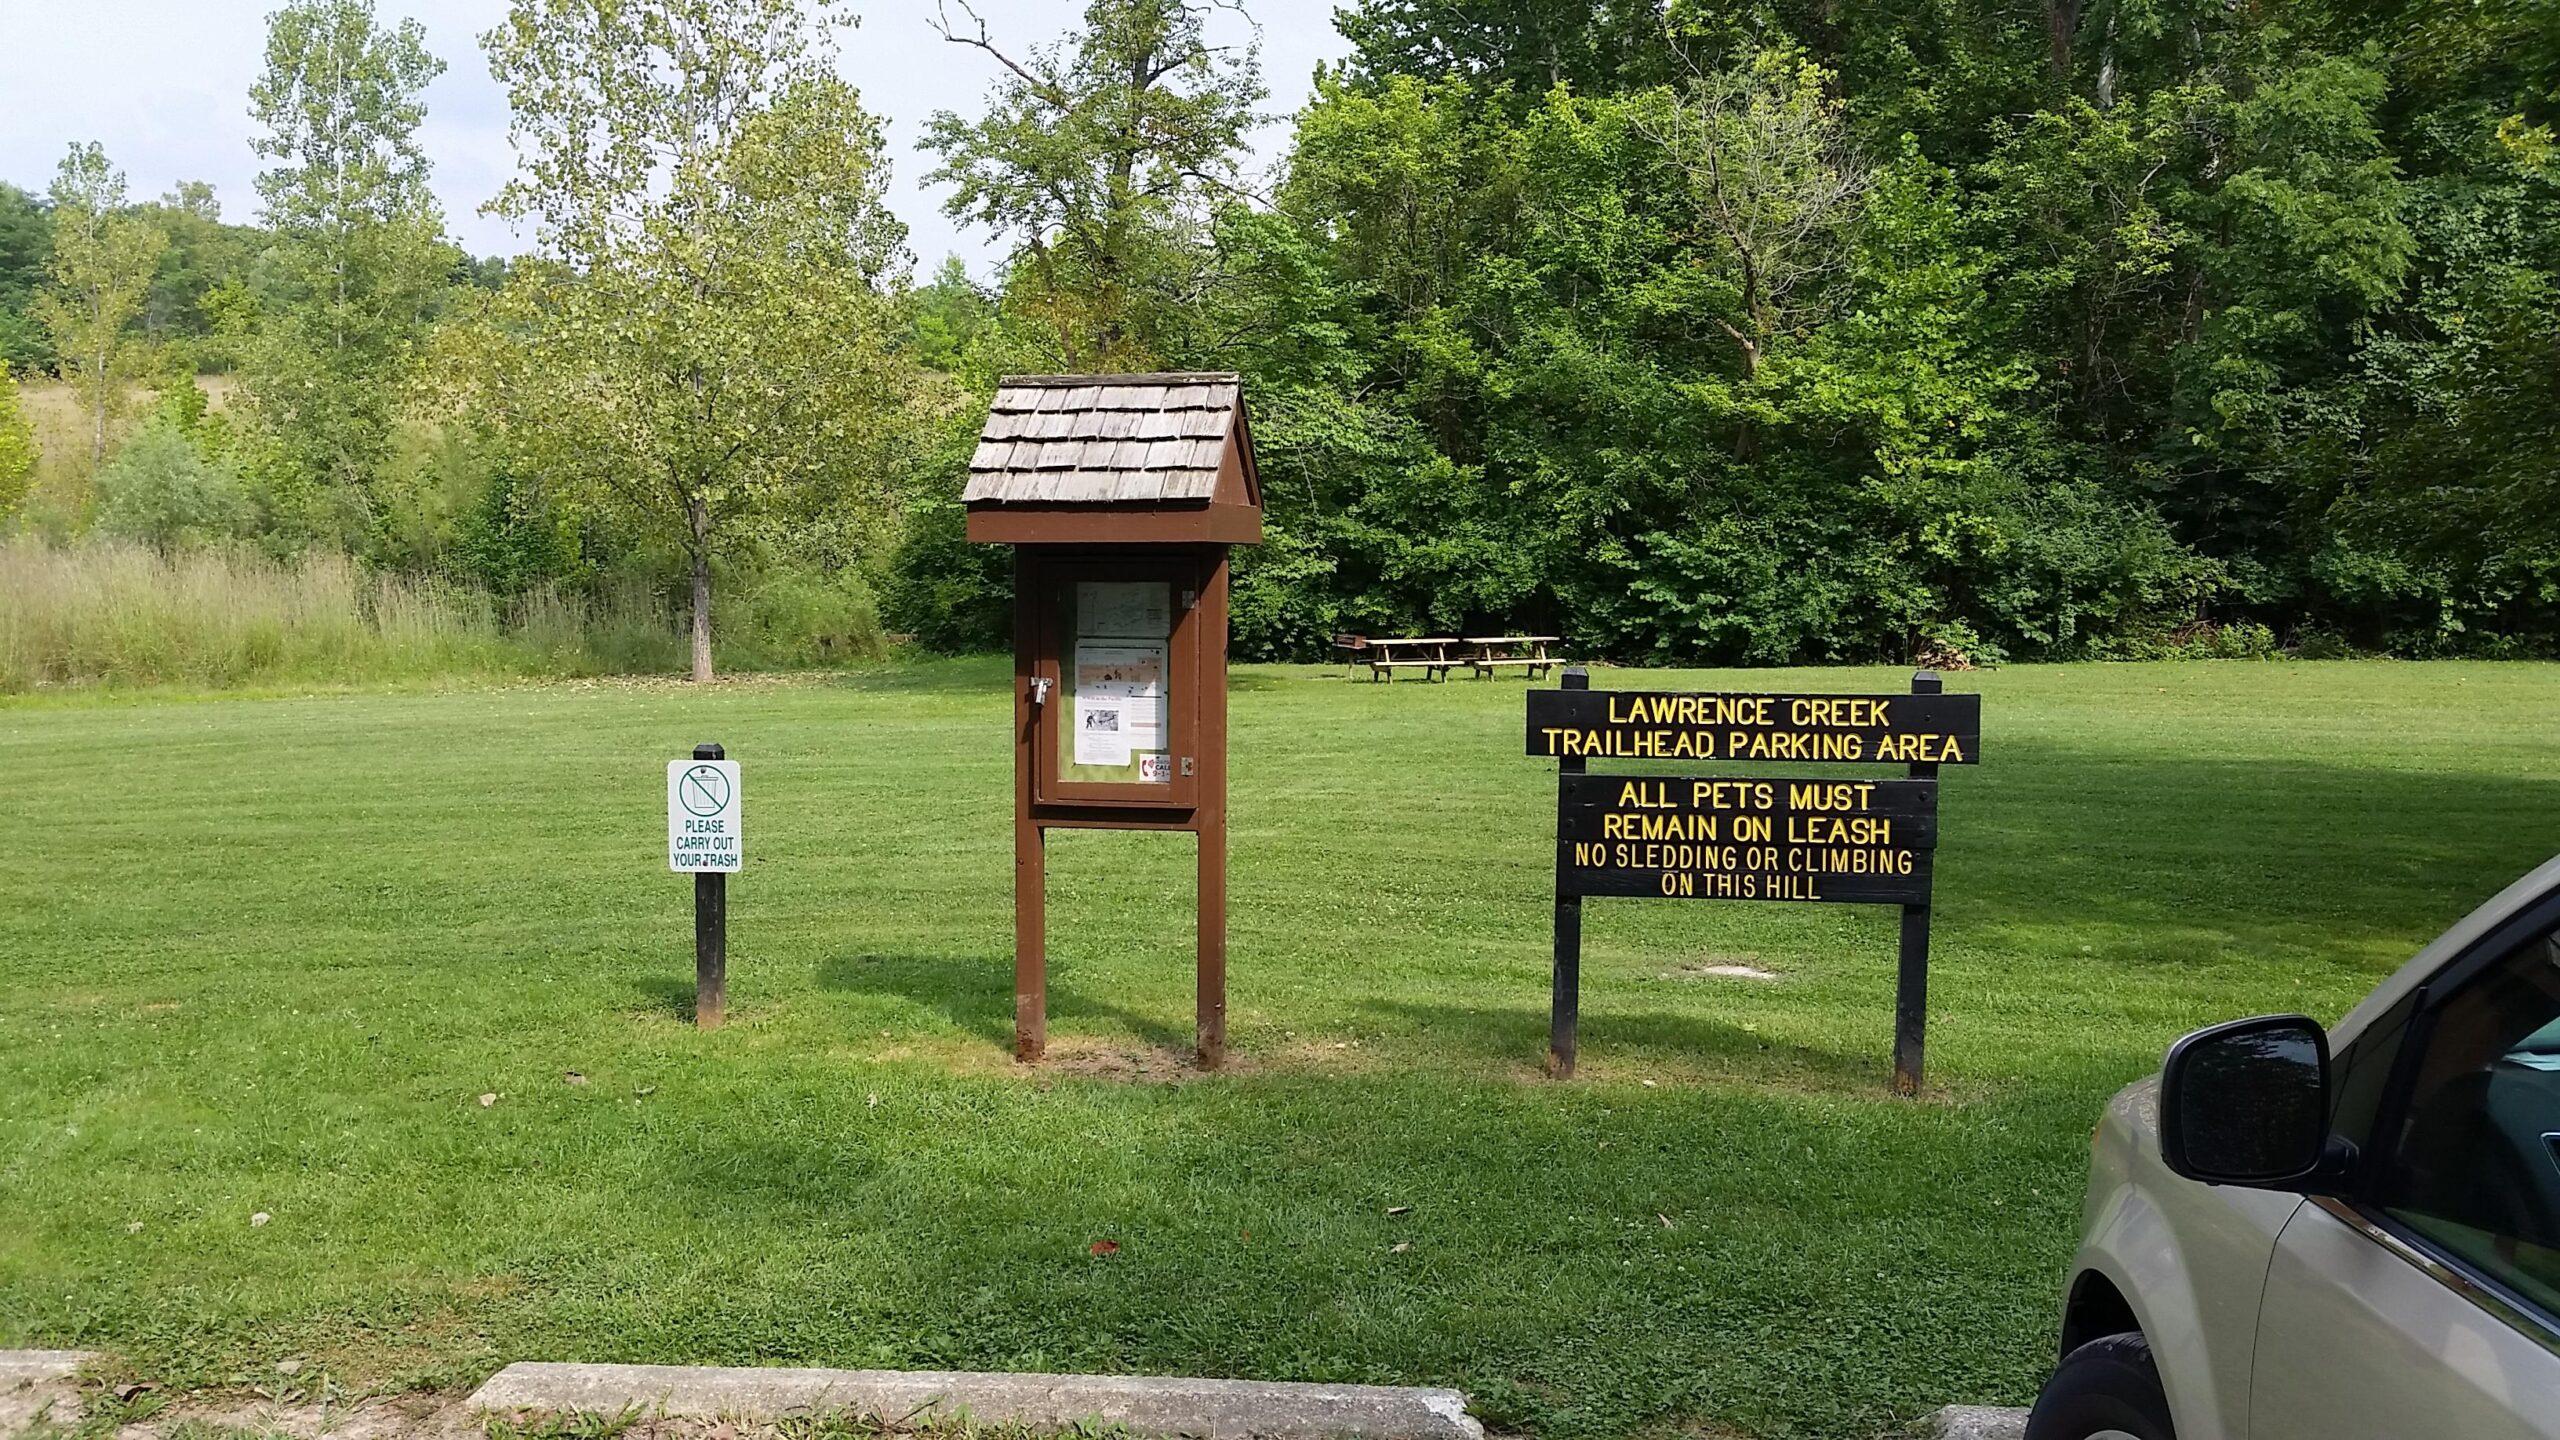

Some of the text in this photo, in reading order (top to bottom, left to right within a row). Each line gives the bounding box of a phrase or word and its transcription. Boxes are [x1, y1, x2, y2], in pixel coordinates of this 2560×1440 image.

[1609, 697, 1890, 727] LAWRENCE CREEK
[1542, 728, 1963, 762] TRAILHEAD PARKING AREA
[1618, 781, 1876, 811] ALL PETS MUST
[685, 820, 724, 833] PLEASE
[1604, 814, 1891, 845] REMAIN ON LEASH
[676, 836, 734, 850] CARRY OUT
[673, 853, 738, 867] YOUR TRASH
[1575, 842, 1913, 875] NO SLEDDING OR CLIMBING
[1661, 872, 1822, 900] ON THIS HILL
